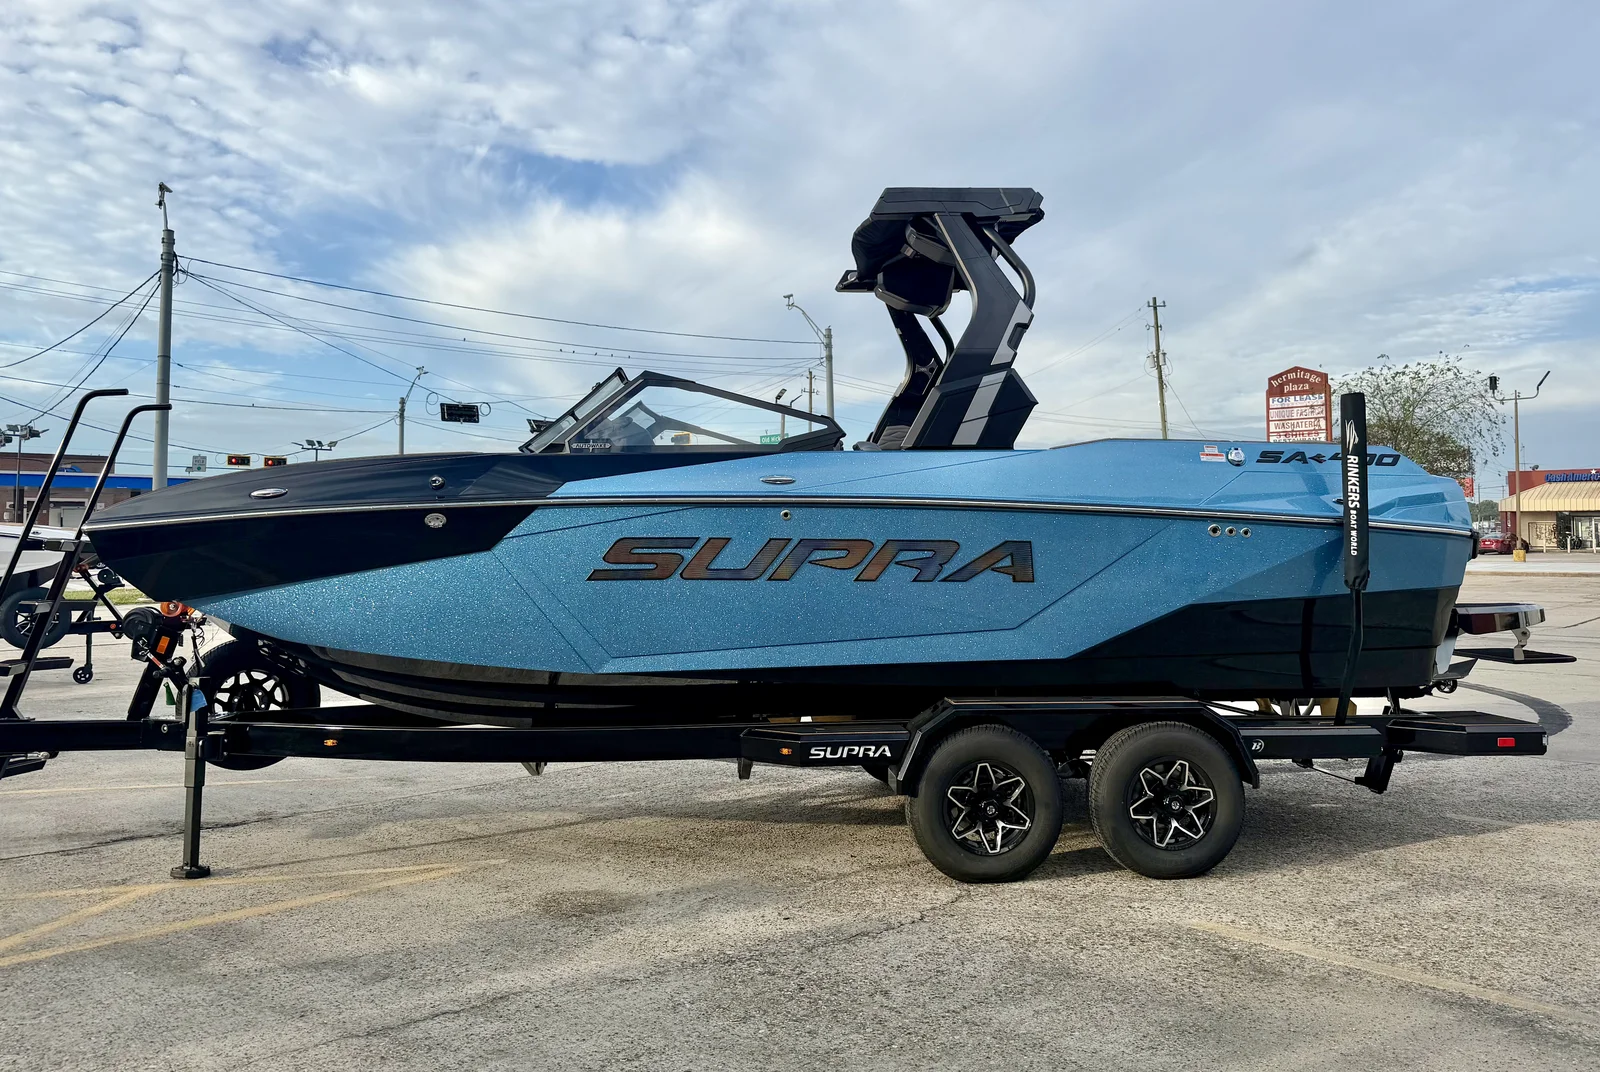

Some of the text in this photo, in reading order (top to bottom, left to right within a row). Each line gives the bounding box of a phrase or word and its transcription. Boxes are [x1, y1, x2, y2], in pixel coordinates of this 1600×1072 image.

[1271, 370, 1321, 387] hermitage
[1284, 383, 1309, 393] plaza
[1294, 394, 1323, 402] LEASE
[1270, 410, 1295, 419] UNIQUE
[1256, 451, 1309, 464] SA
[1545, 473, 1567, 482] Cash
[1347, 455, 1360, 556] RINKERS BOAT WORLD
[585, 537, 1034, 582] SUPRA
[809, 745, 892, 759] SUPRA
